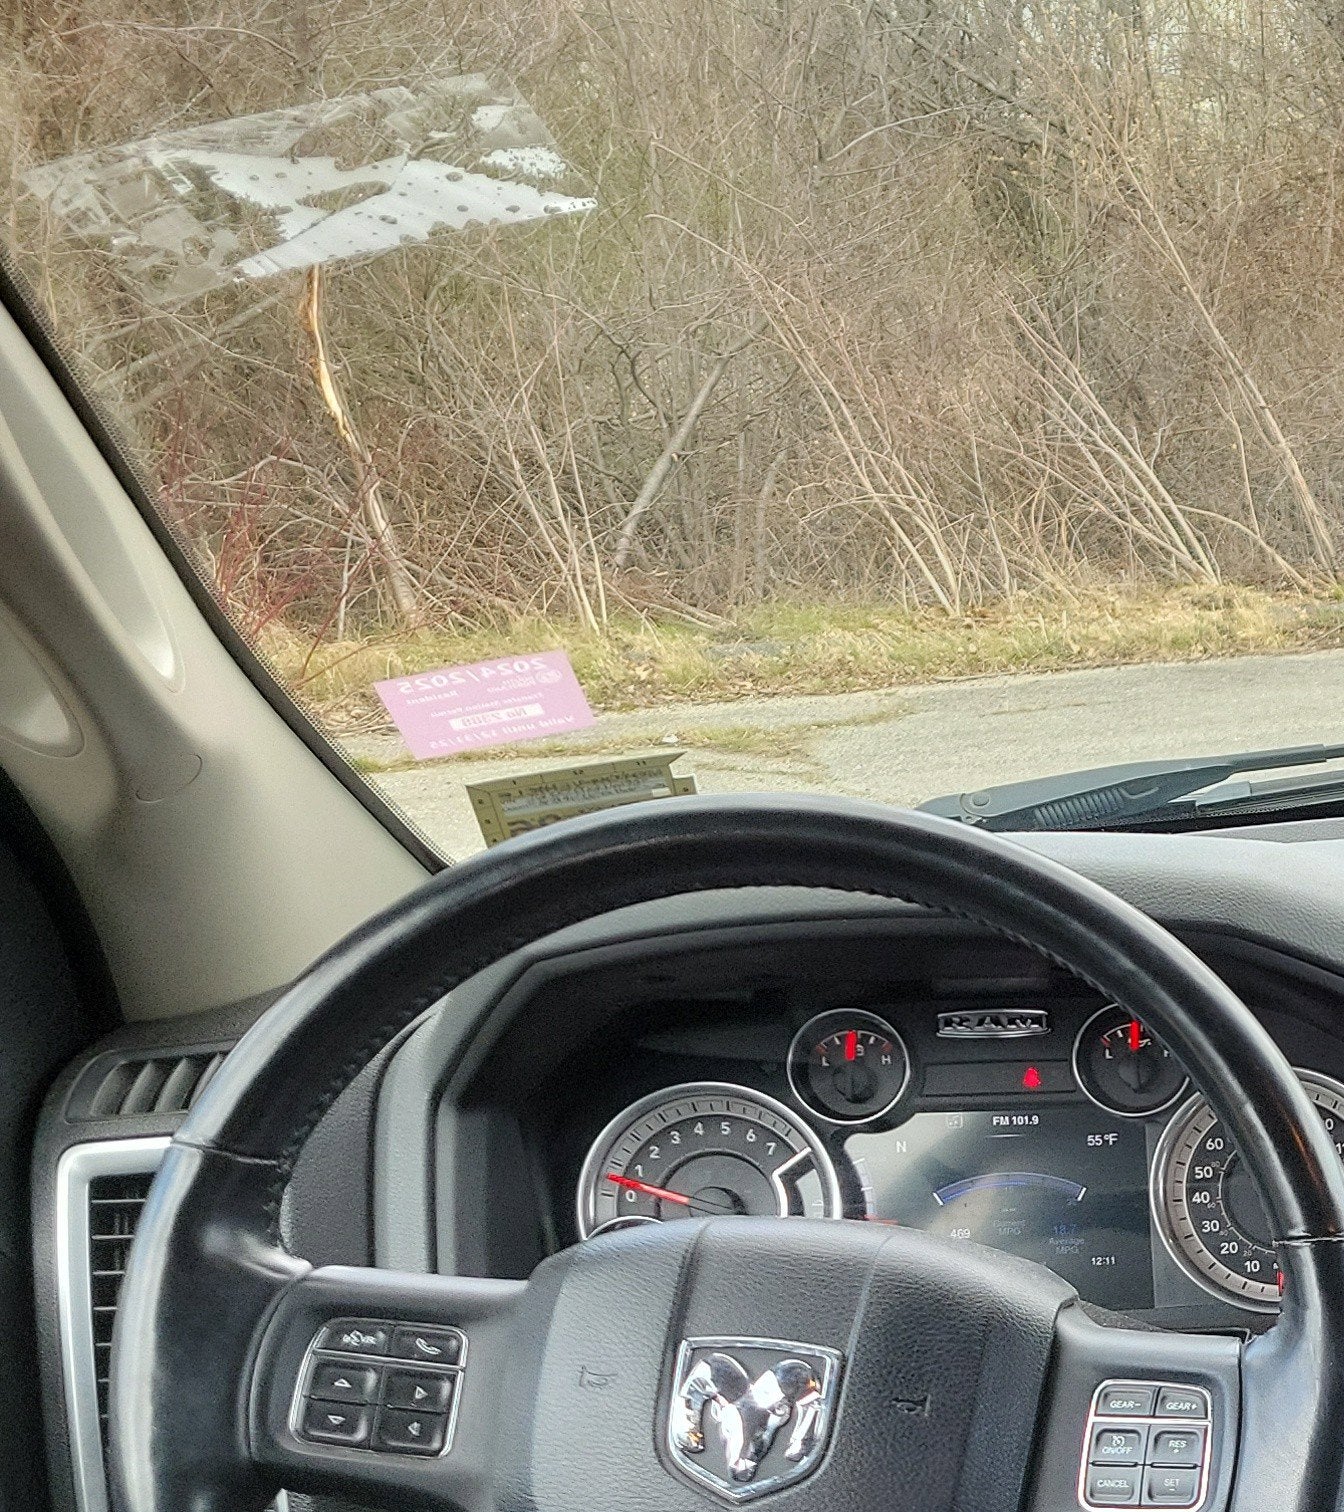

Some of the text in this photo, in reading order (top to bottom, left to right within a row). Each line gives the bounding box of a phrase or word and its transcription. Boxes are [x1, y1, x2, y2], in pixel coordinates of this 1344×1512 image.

[992, 1115, 1040, 1126] FM 101.9
[693, 1122, 704, 1136] 4
[720, 1122, 731, 1135] 5
[670, 1130, 682, 1145] 3
[746, 1129, 757, 1143] 6
[766, 1142, 776, 1156] 7
[896, 1140, 907, 1154] N
[1206, 1138, 1224, 1151] 60
[649, 1146, 660, 1159] 2
[634, 1165, 642, 1177] 1
[1194, 1166, 1213, 1179] 50
[626, 1190, 636, 1203] 0
[1192, 1192, 1210, 1204] 40
[1202, 1220, 1220, 1232] 30
[950, 1228, 970, 1239] 469
[1220, 1242, 1238, 1254] 20
[1090, 1256, 1116, 1266] 12:11
[1244, 1260, 1260, 1272] 10
[1102, 1446, 1132, 1454] ON/OFF
[1168, 1440, 1188, 1448] RES
[1096, 1480, 1130, 1488] CANCEL
[1163, 1478, 1180, 1486] SET
